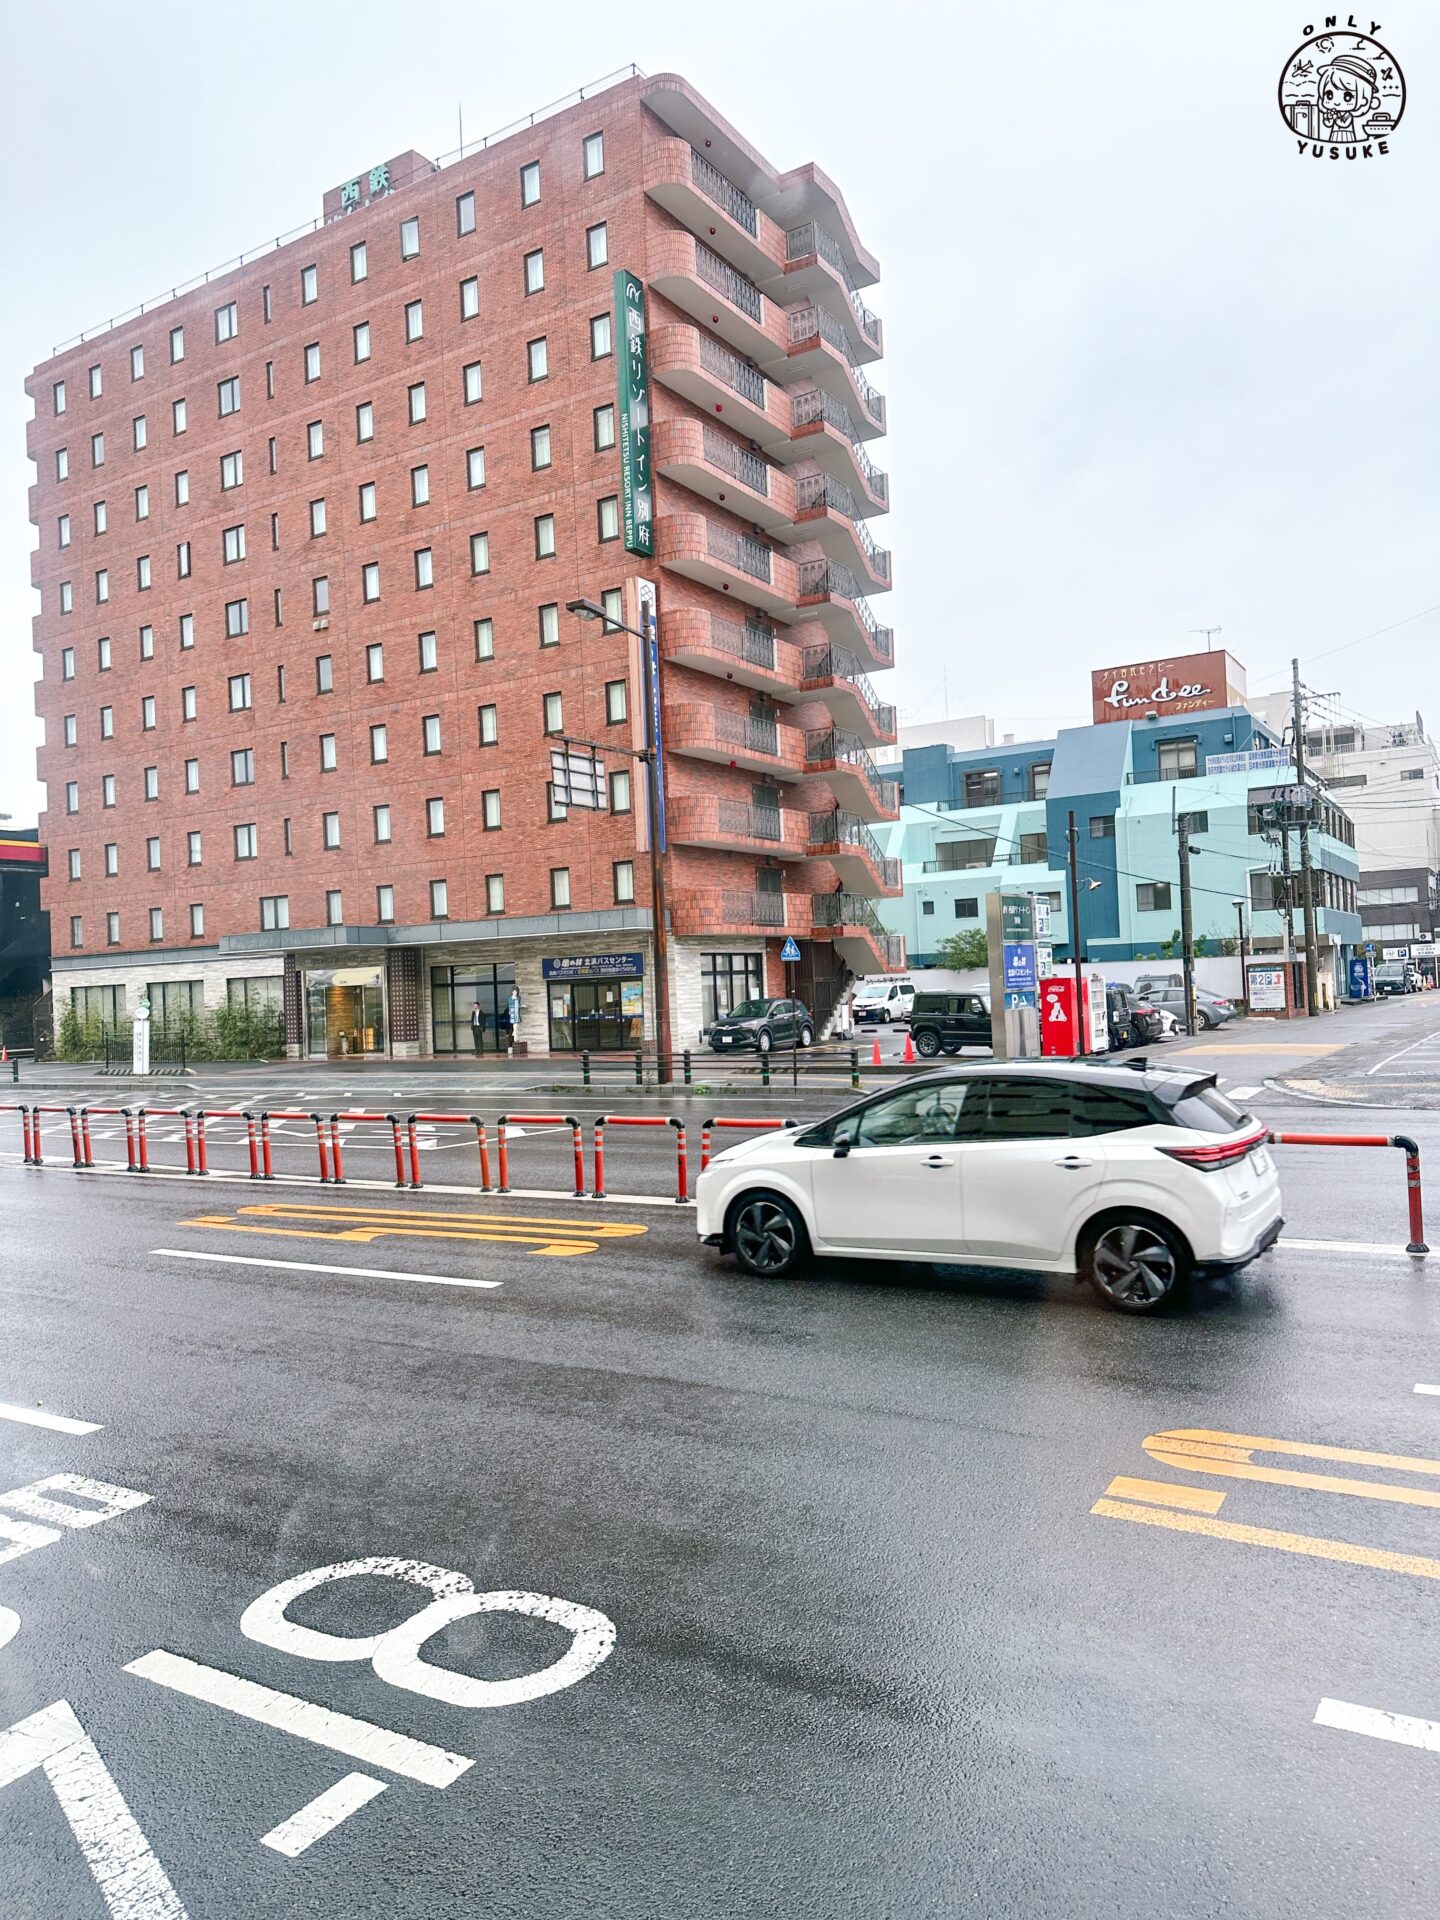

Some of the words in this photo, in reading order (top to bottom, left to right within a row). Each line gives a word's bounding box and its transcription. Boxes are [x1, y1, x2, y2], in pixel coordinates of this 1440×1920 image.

[621, 413, 630, 464] NISHITETSU
[623, 465, 632, 499] RESORT
[626, 520, 634, 548] BEPPU
[1011, 994, 1019, 1009] P
